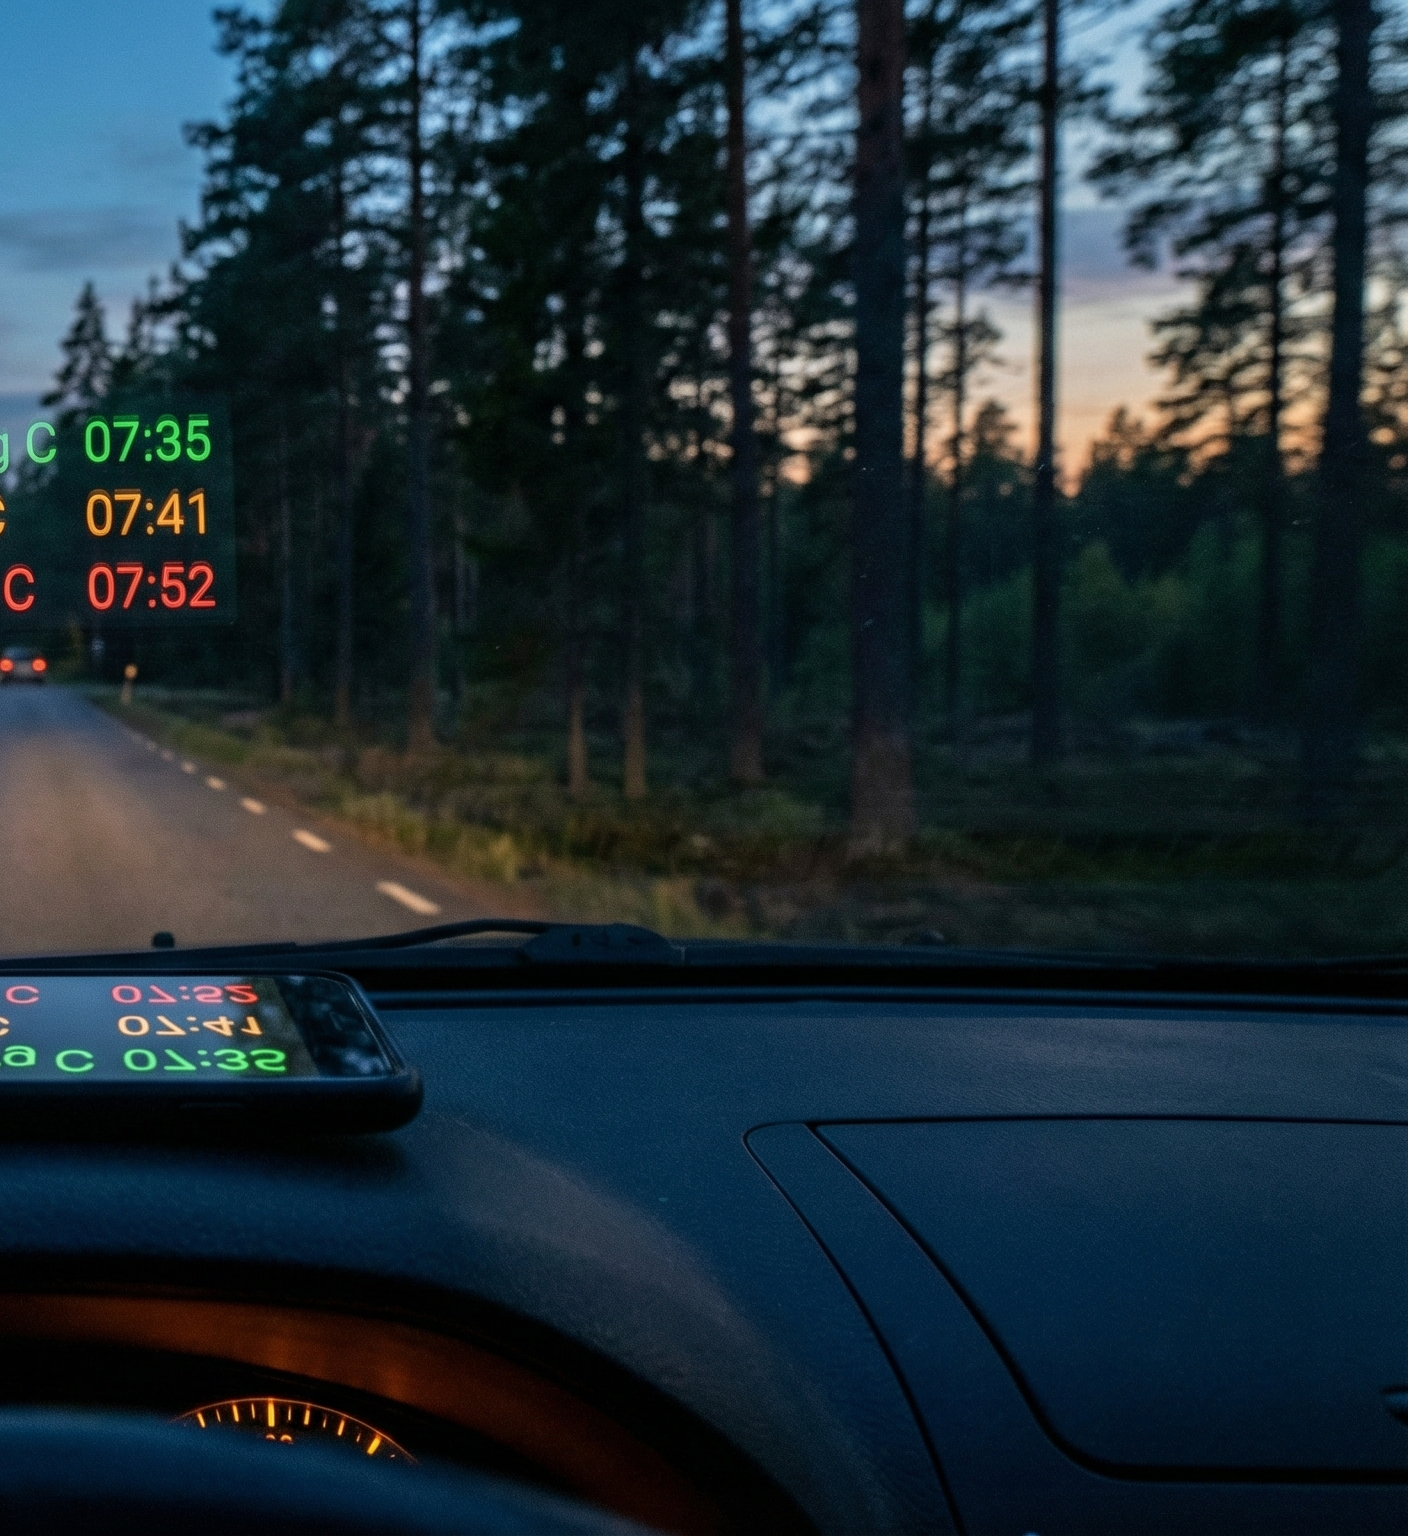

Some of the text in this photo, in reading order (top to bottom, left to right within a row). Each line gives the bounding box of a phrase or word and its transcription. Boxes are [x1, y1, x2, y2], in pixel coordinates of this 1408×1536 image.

[27, 423, 56, 463] C
[86, 420, 210, 462] 07:35
[87, 493, 205, 536] 07:41
[4, 568, 34, 611] C
[89, 565, 215, 609] 07:52
